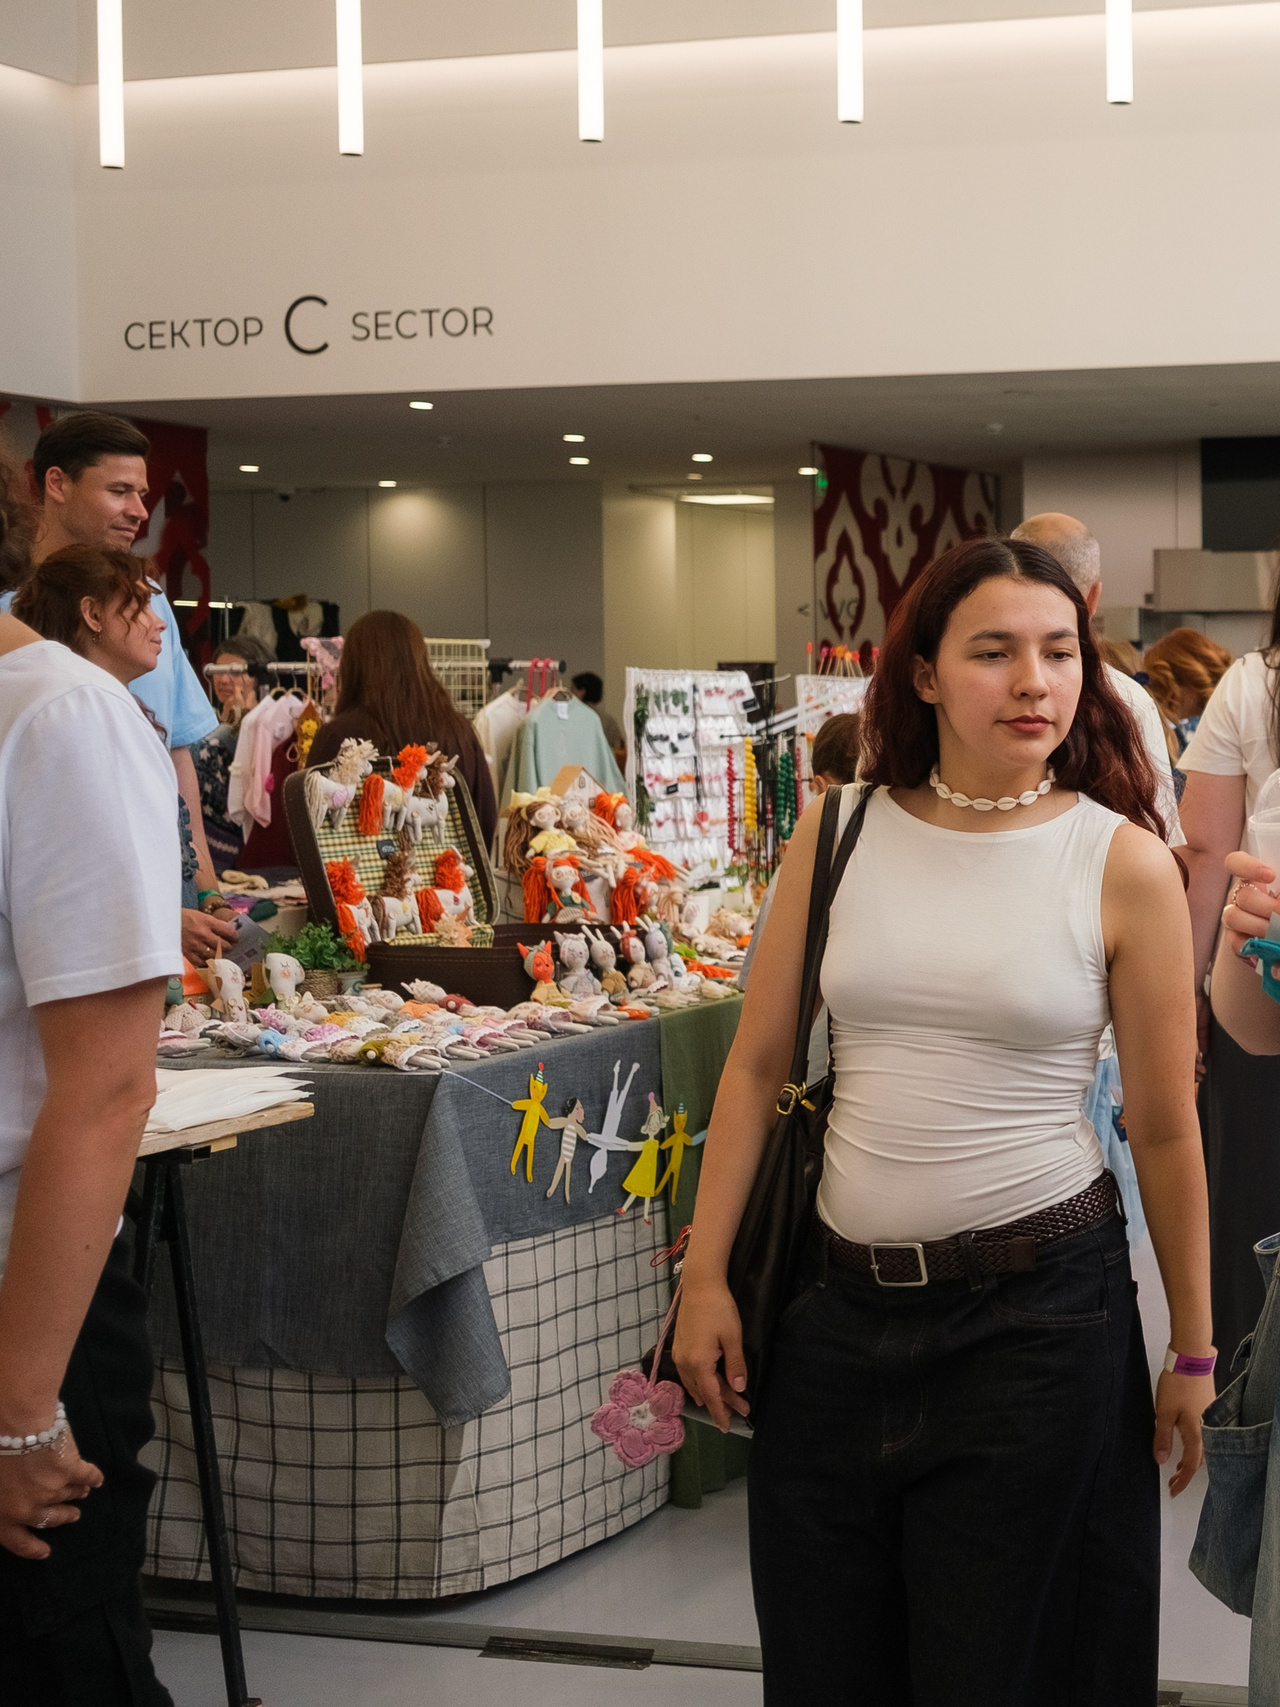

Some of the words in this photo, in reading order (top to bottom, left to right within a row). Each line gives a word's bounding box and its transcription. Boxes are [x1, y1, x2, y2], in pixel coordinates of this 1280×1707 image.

[124, 316, 264, 351] СЕКТОР
[284, 294, 330, 356] C
[351, 306, 494, 341] SECTOR
